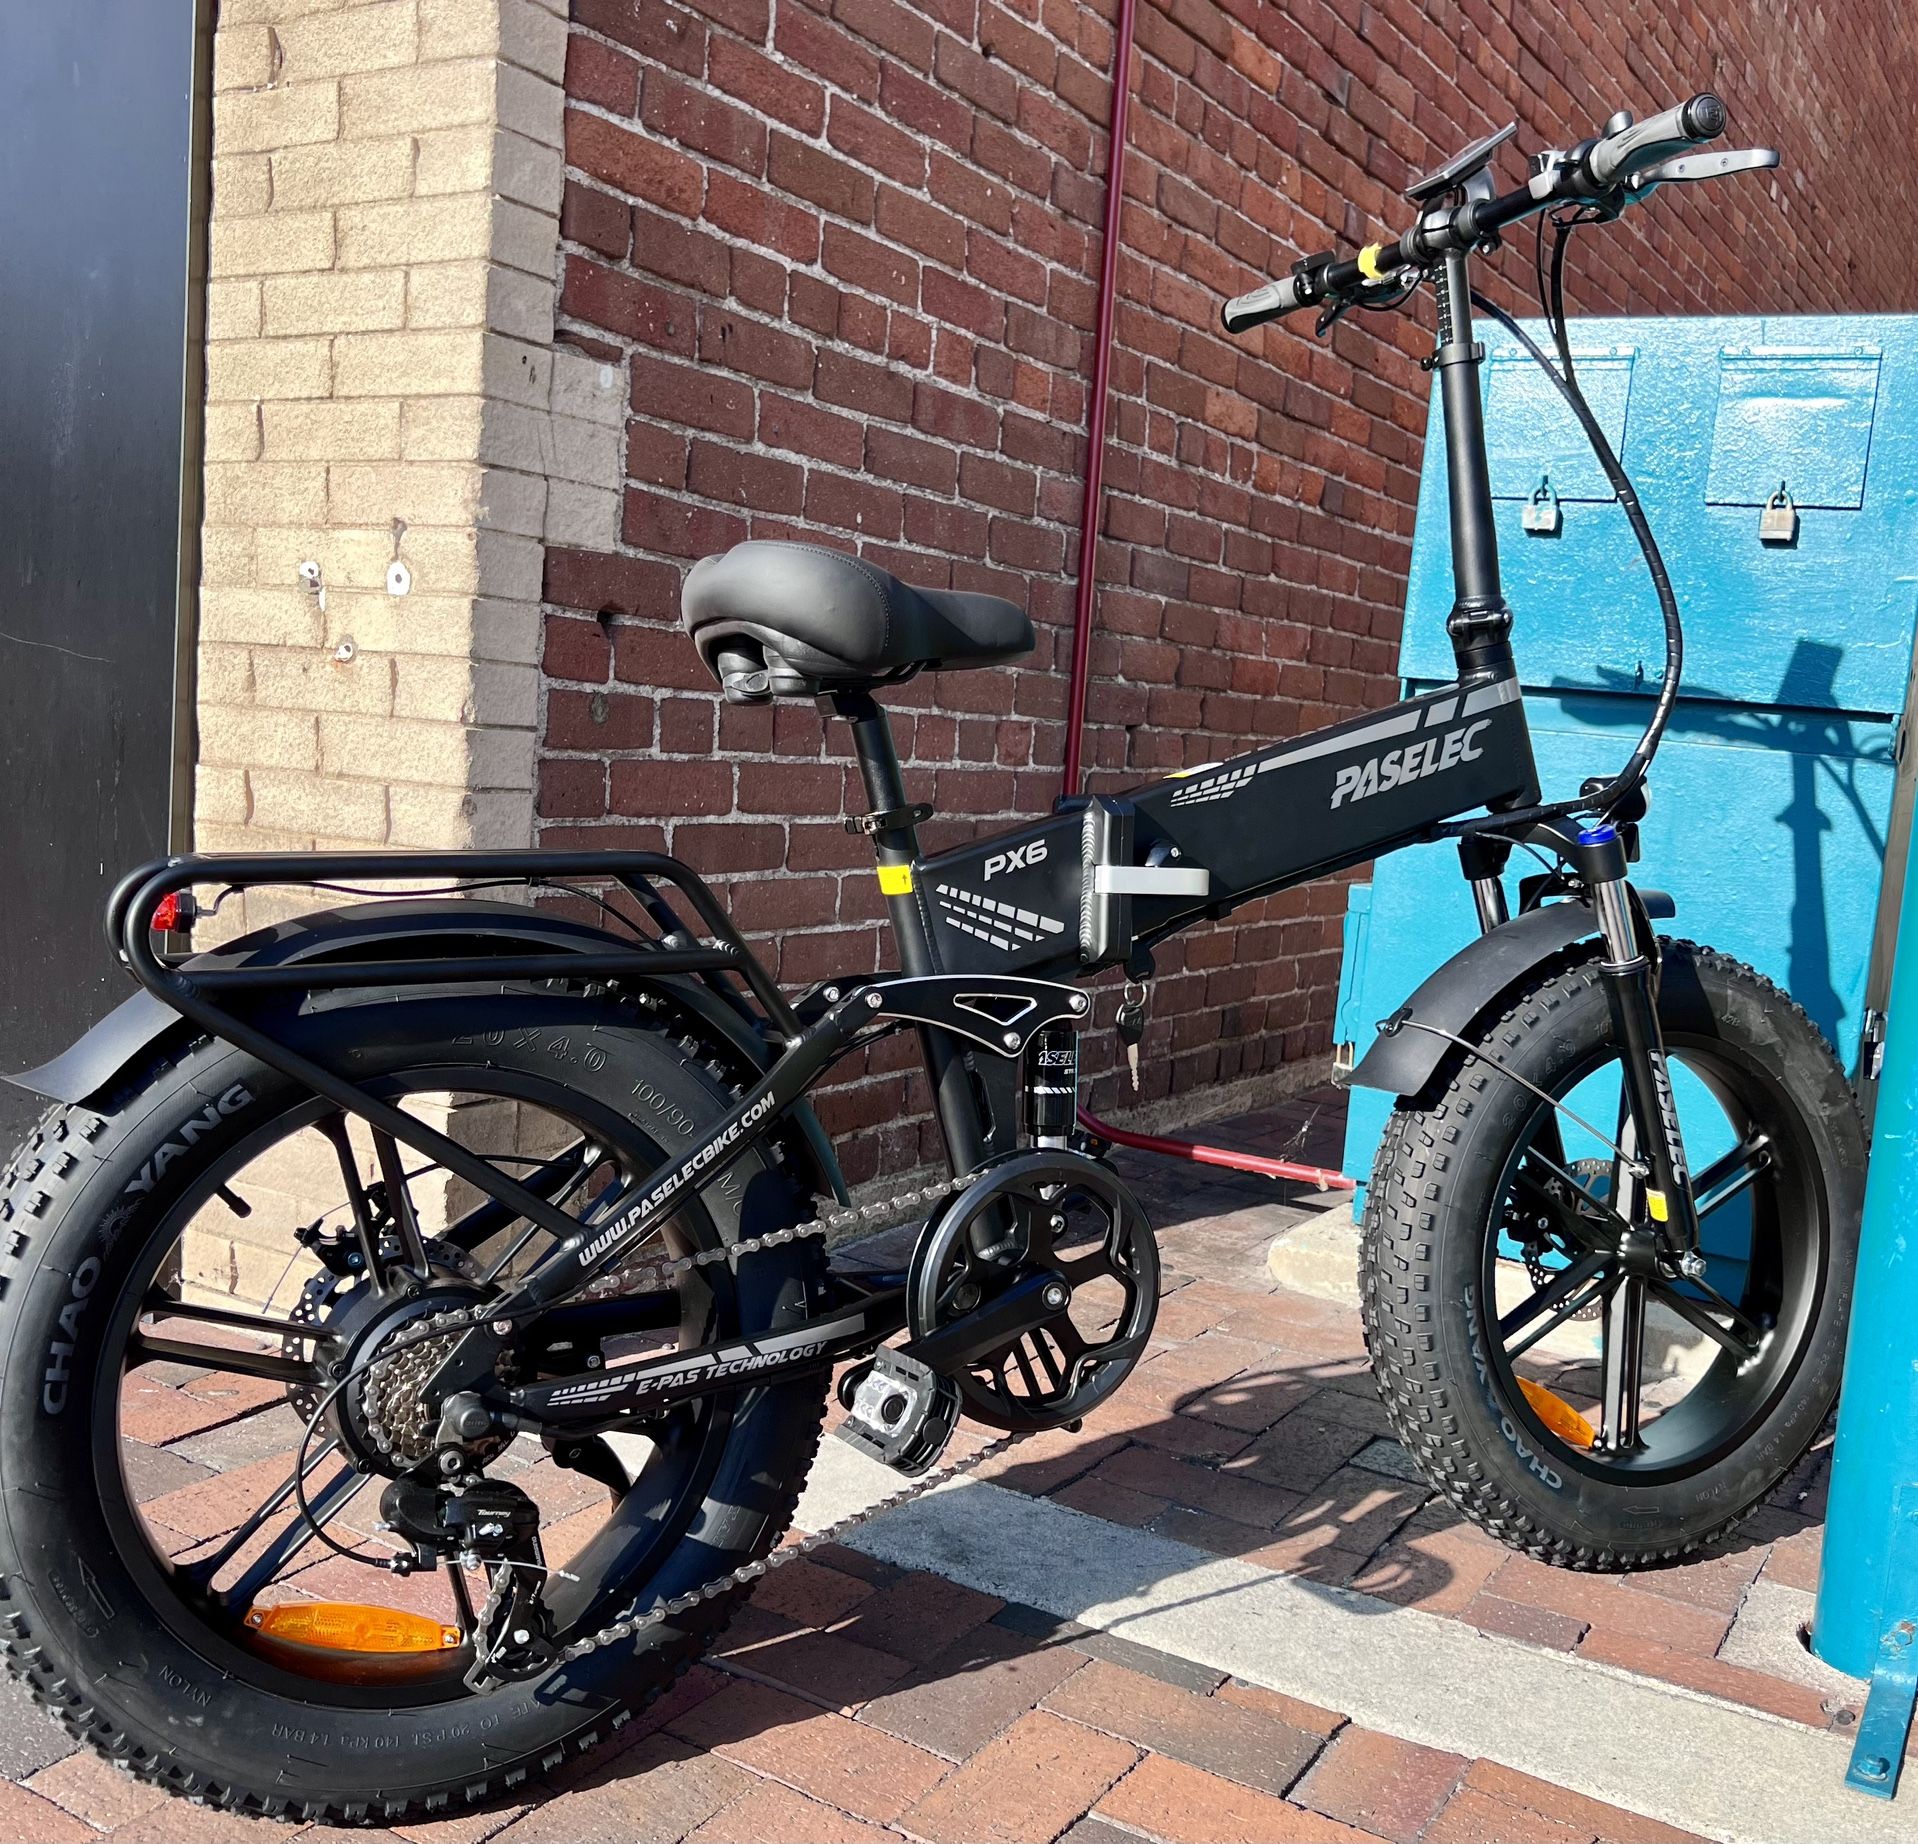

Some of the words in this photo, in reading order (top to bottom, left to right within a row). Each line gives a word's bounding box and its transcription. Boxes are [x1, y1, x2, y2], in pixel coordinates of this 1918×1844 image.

[1330, 718, 1493, 810] PASELEC
[983, 839, 1048, 882] PX6
[578, 1091, 776, 1268] WWW.PASELECBIKE.COM
[43, 1256, 100, 1415] CHAO
[126, 1083, 257, 1195] YANG
[636, 1368, 701, 1396] E-PAS
[704, 1340, 827, 1381] TECHNOLOGY
[1501, 1416, 1563, 1489] CHAO
[477, 1508, 512, 1518] Tourney
[158, 1664, 213, 1708] NYLON
